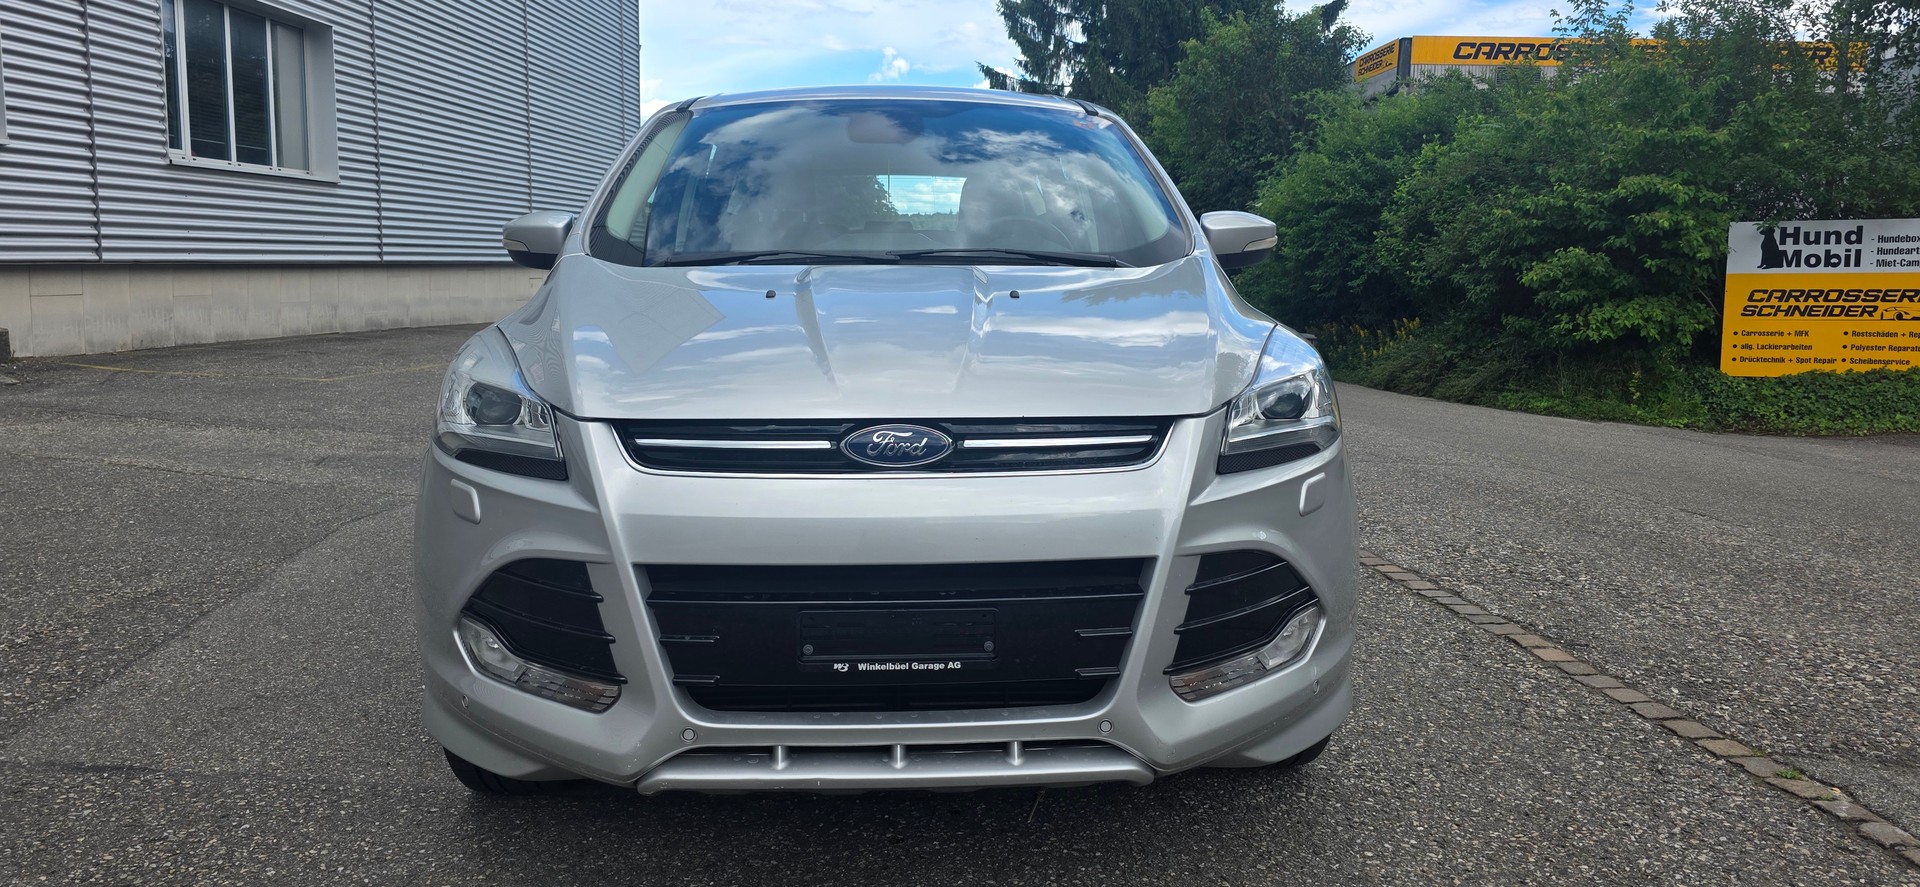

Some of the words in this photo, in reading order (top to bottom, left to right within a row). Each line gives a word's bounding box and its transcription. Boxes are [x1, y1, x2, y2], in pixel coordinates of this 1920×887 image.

[1779, 226, 1863, 245] Hund
[1780, 249, 1861, 268] Mobil
[1876, 258, 1920, 268] Miet-Cam
[1740, 305, 1879, 317] SCHNEIDER
[1850, 344, 1887, 352] Polyester
[1795, 357, 1812, 365] Spot
[1813, 357, 1838, 365] Repair
[1849, 358, 1911, 366] Scheibenservice
[866, 430, 929, 457] Ford
[857, 663, 909, 671] Winkelbüel
[911, 662, 946, 671] Garage
[947, 661, 962, 669] AG
